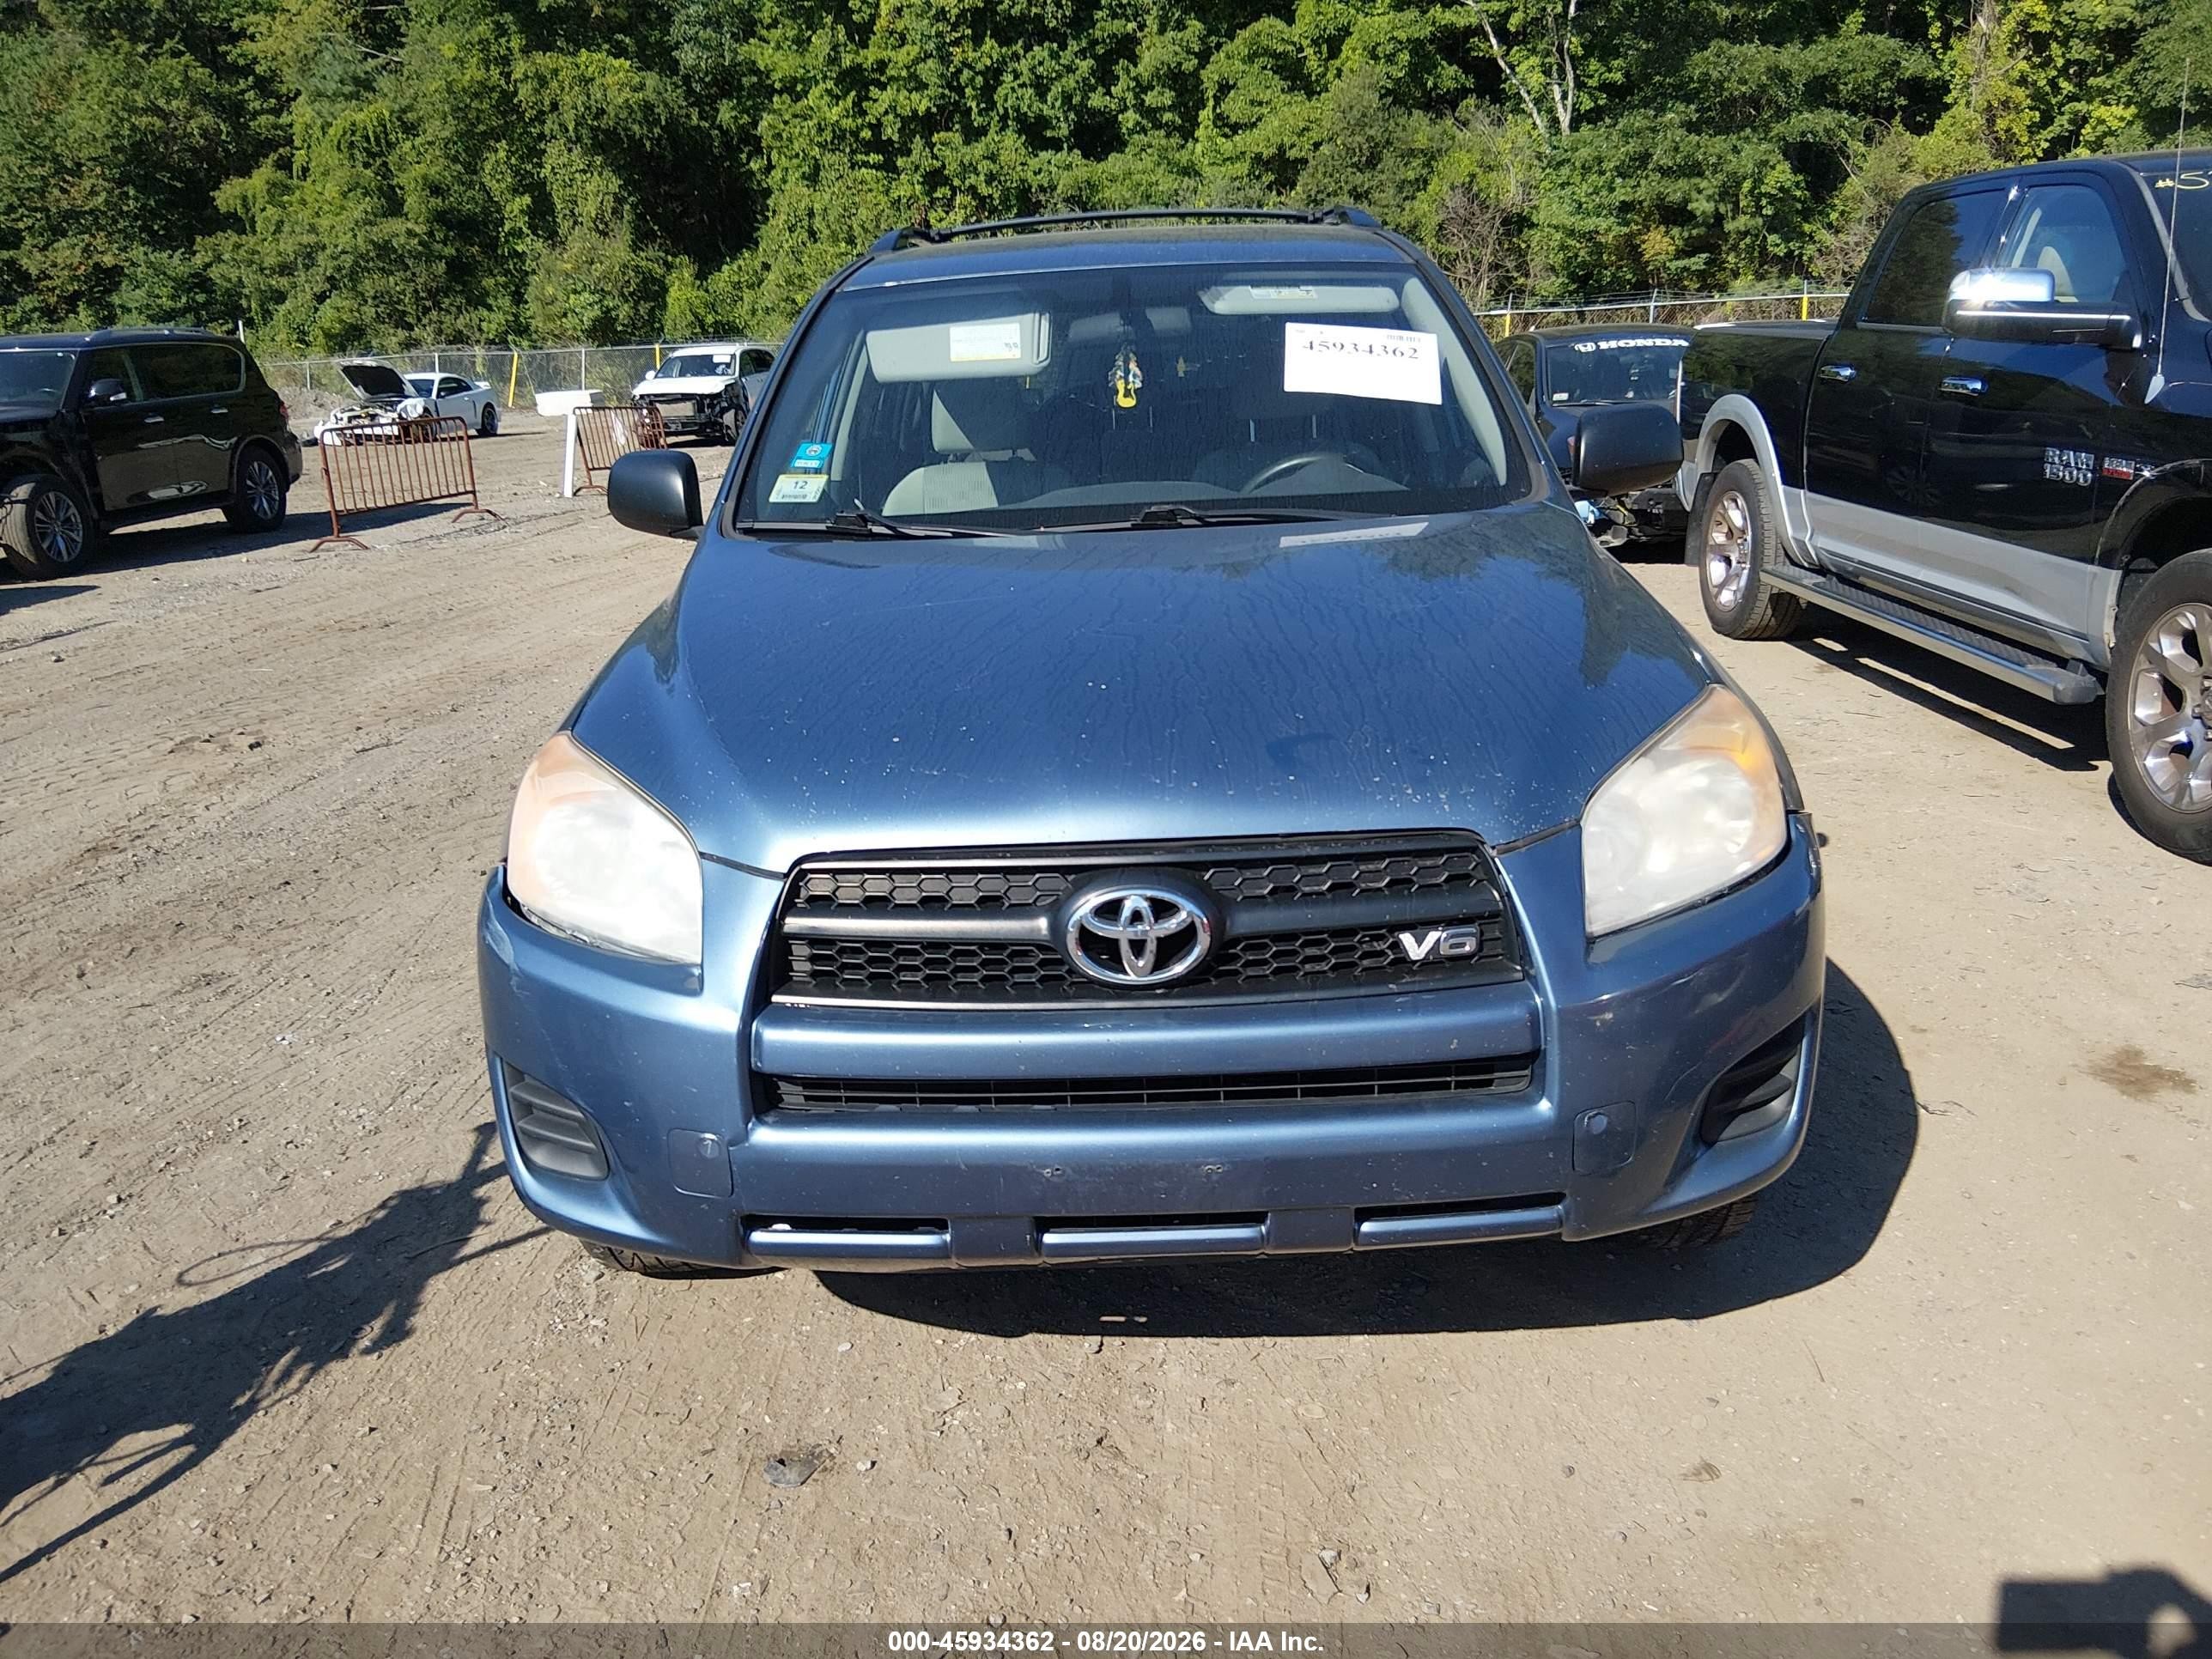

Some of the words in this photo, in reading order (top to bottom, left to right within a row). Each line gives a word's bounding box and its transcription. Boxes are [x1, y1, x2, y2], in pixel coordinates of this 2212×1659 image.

[1302, 339, 1419, 360] 45934362
[1597, 338, 1690, 350] HONDA
[2043, 447, 2095, 470] RAM
[793, 481, 808, 489] 12
[2042, 462, 2094, 487] 1500
[1398, 927, 1477, 961] V6
